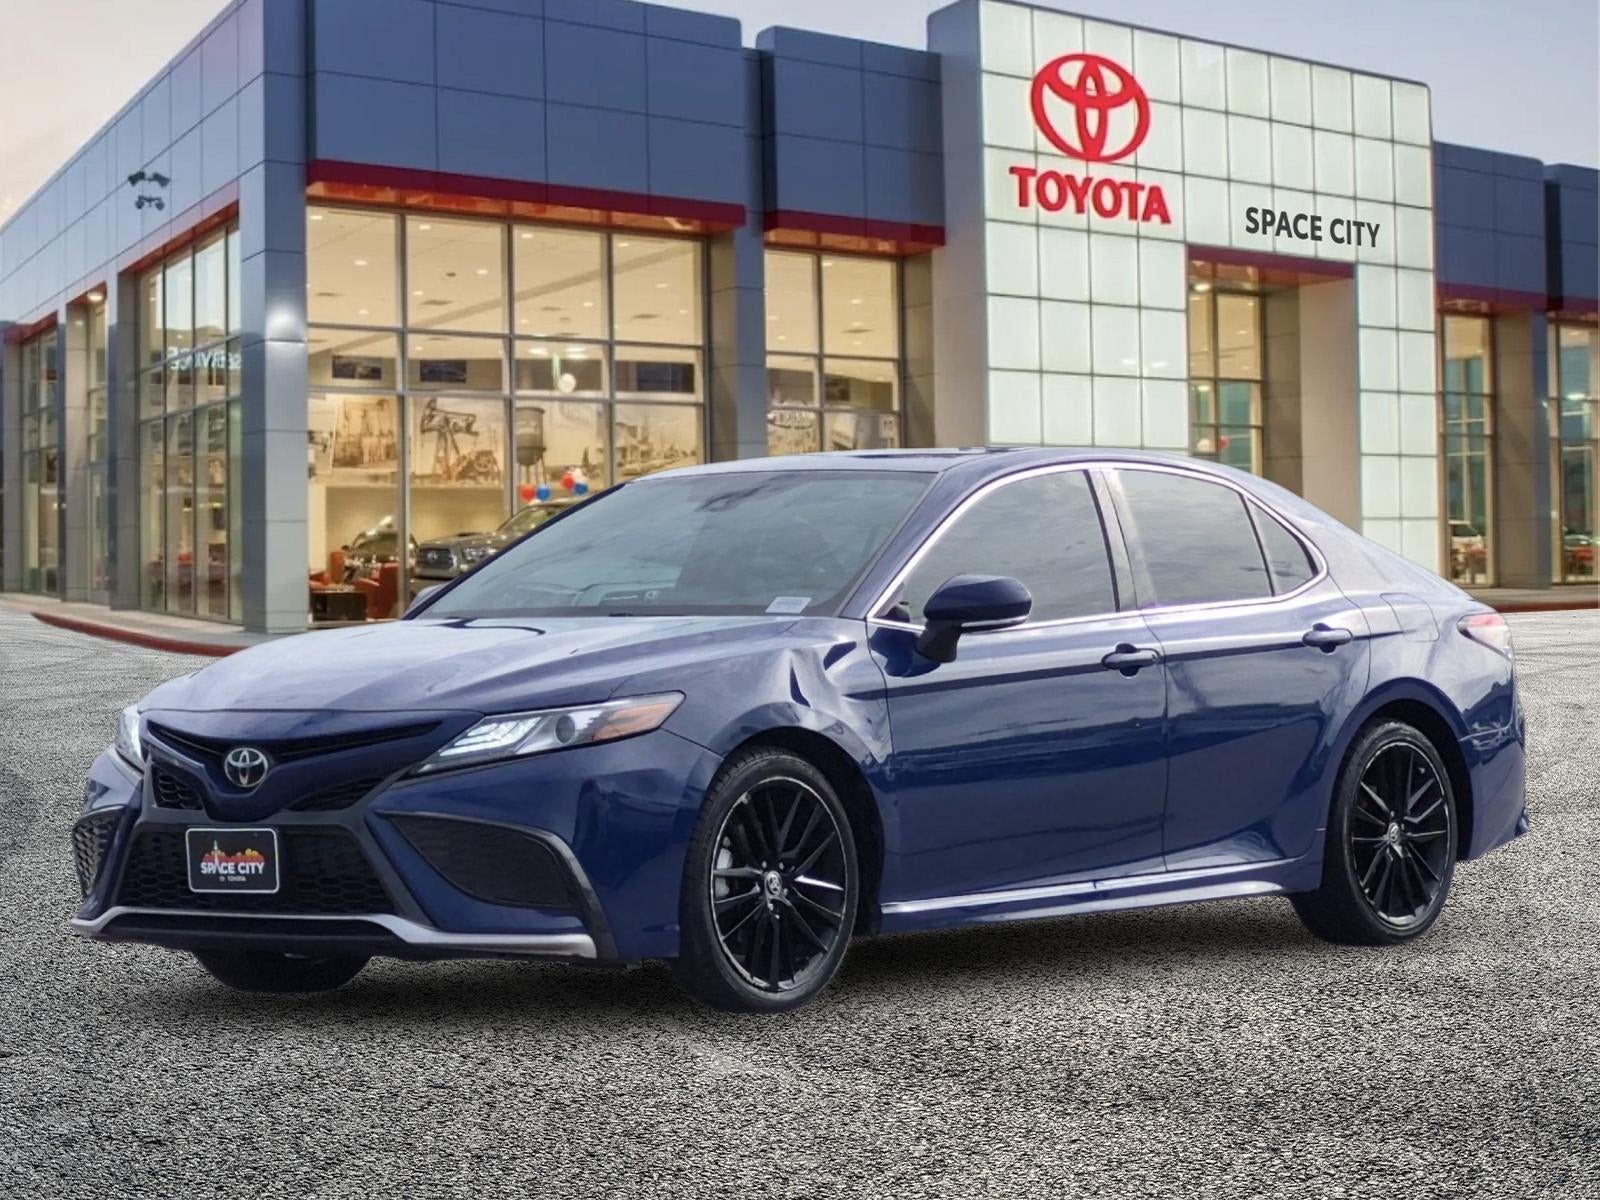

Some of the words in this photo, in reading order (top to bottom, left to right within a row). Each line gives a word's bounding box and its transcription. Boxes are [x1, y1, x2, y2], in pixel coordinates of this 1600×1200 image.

[1009, 166, 1171, 225] TOYOTA
[1245, 207, 1322, 242] SPACE
[1329, 218, 1381, 248] CITY
[200, 862, 235, 874] SPACE
[237, 862, 265, 874] CITY
